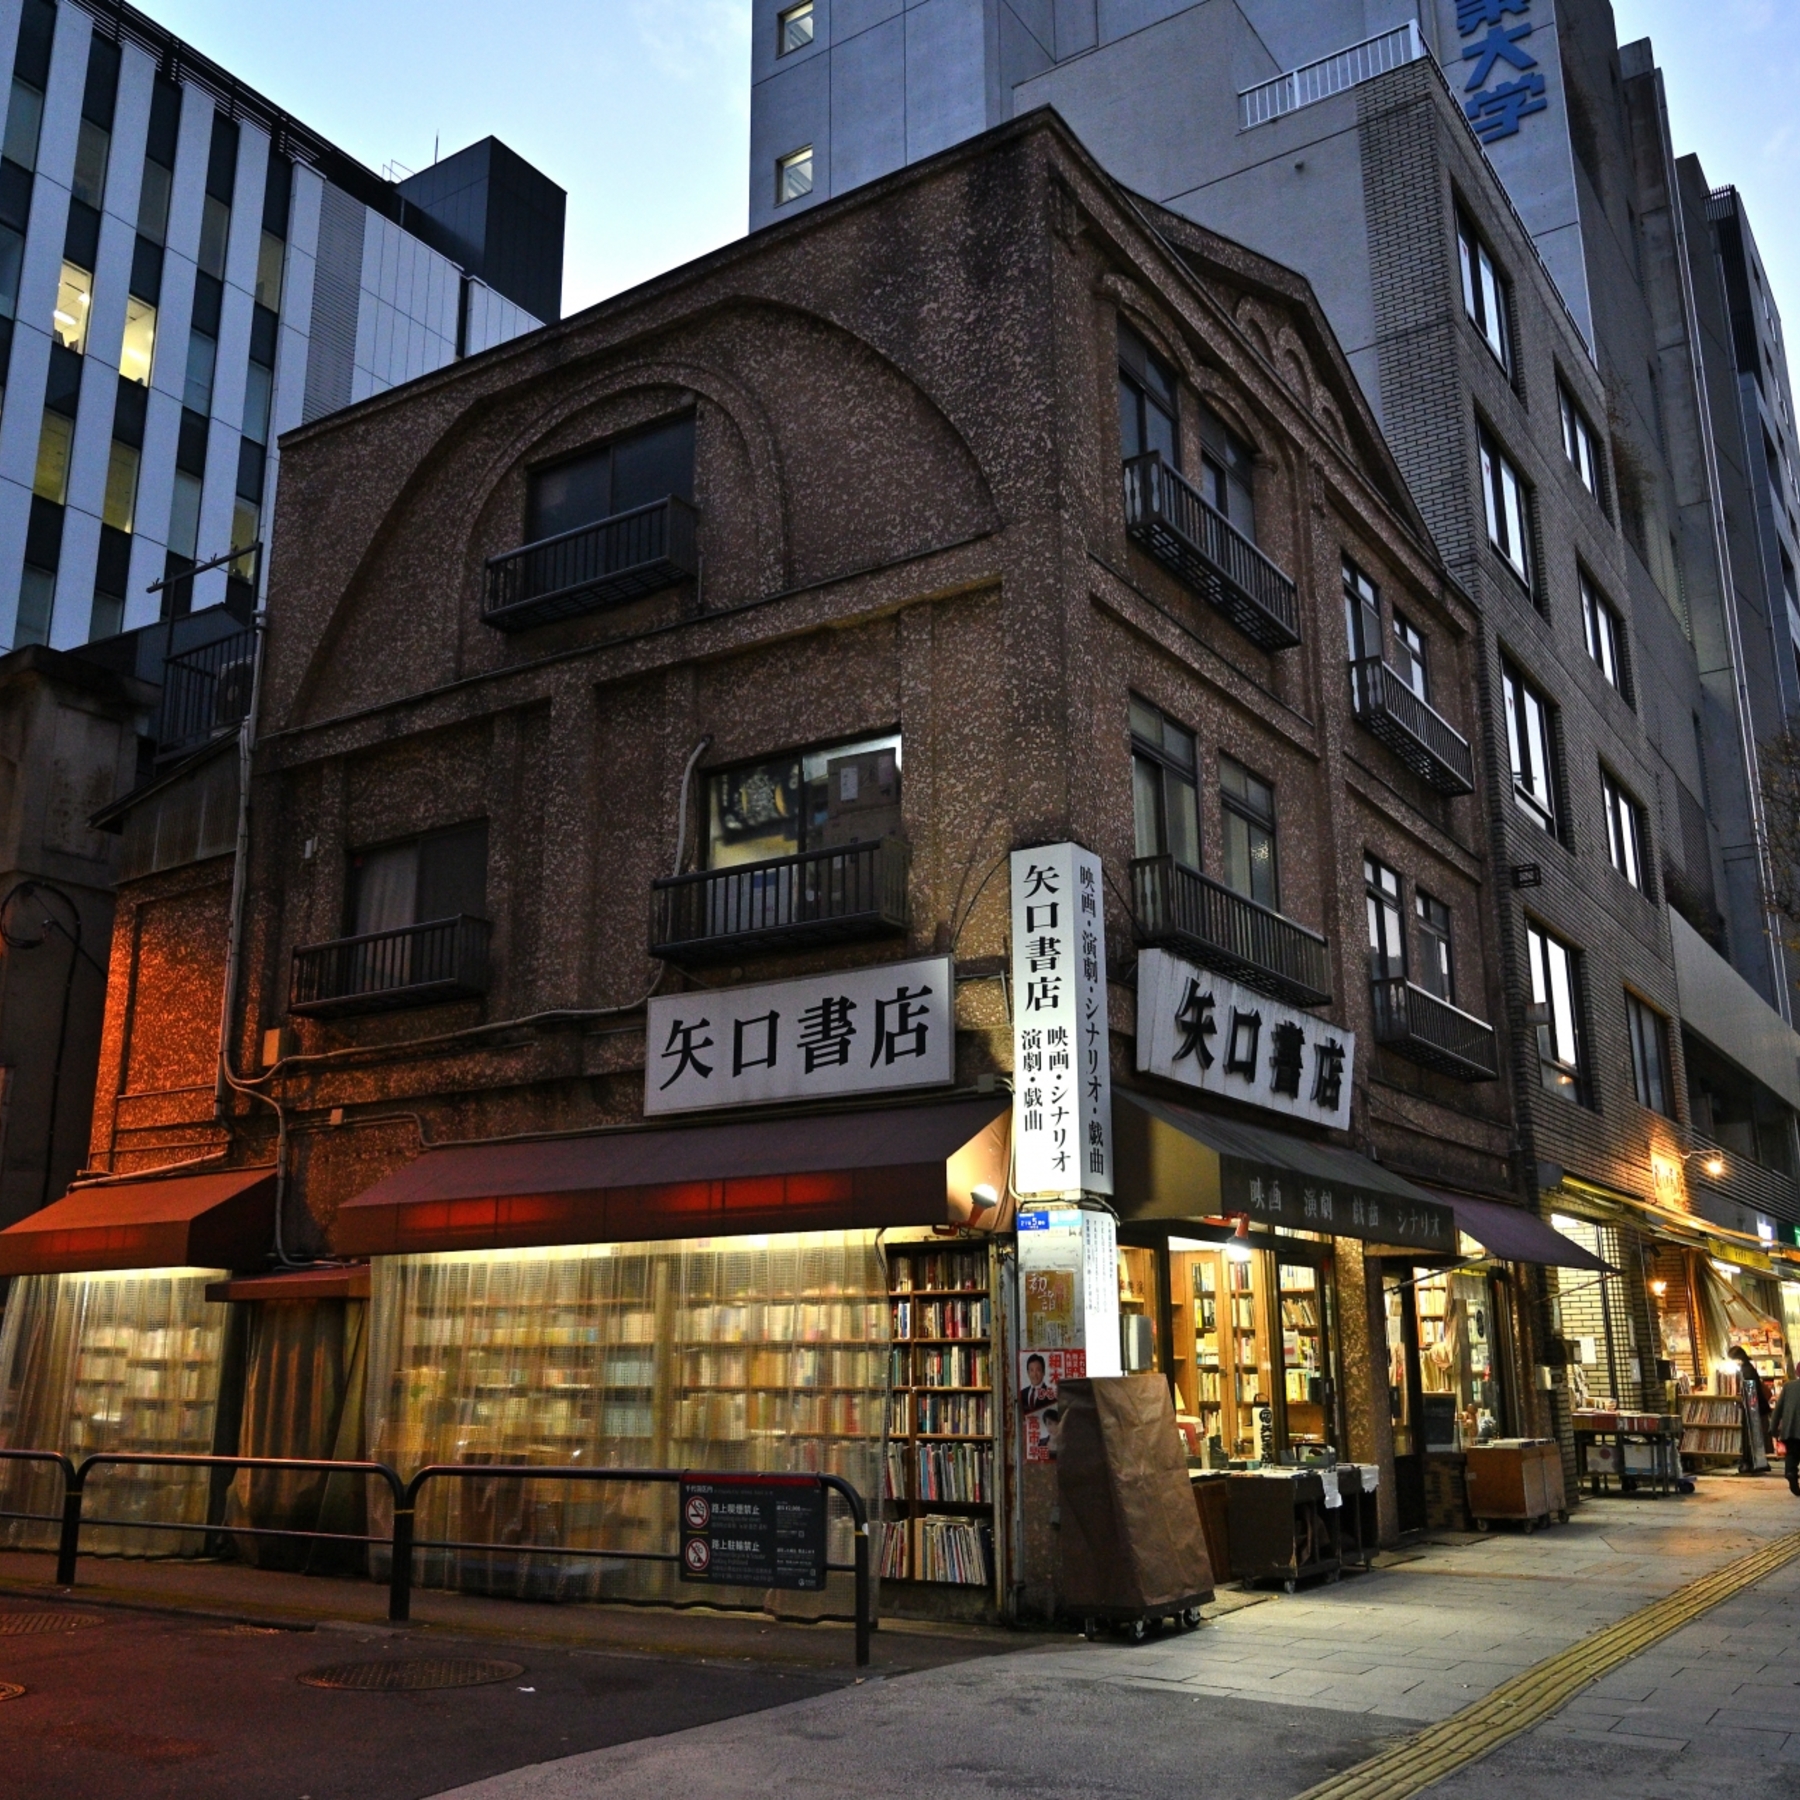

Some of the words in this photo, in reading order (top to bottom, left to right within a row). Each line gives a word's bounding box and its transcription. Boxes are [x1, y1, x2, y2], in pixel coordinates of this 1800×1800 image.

[1023, 864, 1063, 1012] 矢口書店
[659, 984, 933, 1092] 矢口書店
[1021, 1028, 1043, 1132] 演劇・戯曲
[1079, 864, 1105, 1176] 映画・演劇・シナリオ・戯曲
[1172, 976, 1346, 1112] 矢口書店
[1047, 1025, 1072, 1173] 映画・シナリオ
[1250, 1176, 1282, 1212] 映画
[1304, 1187, 1334, 1222] 演劇
[1398, 1208, 1441, 1238] シナリオ
